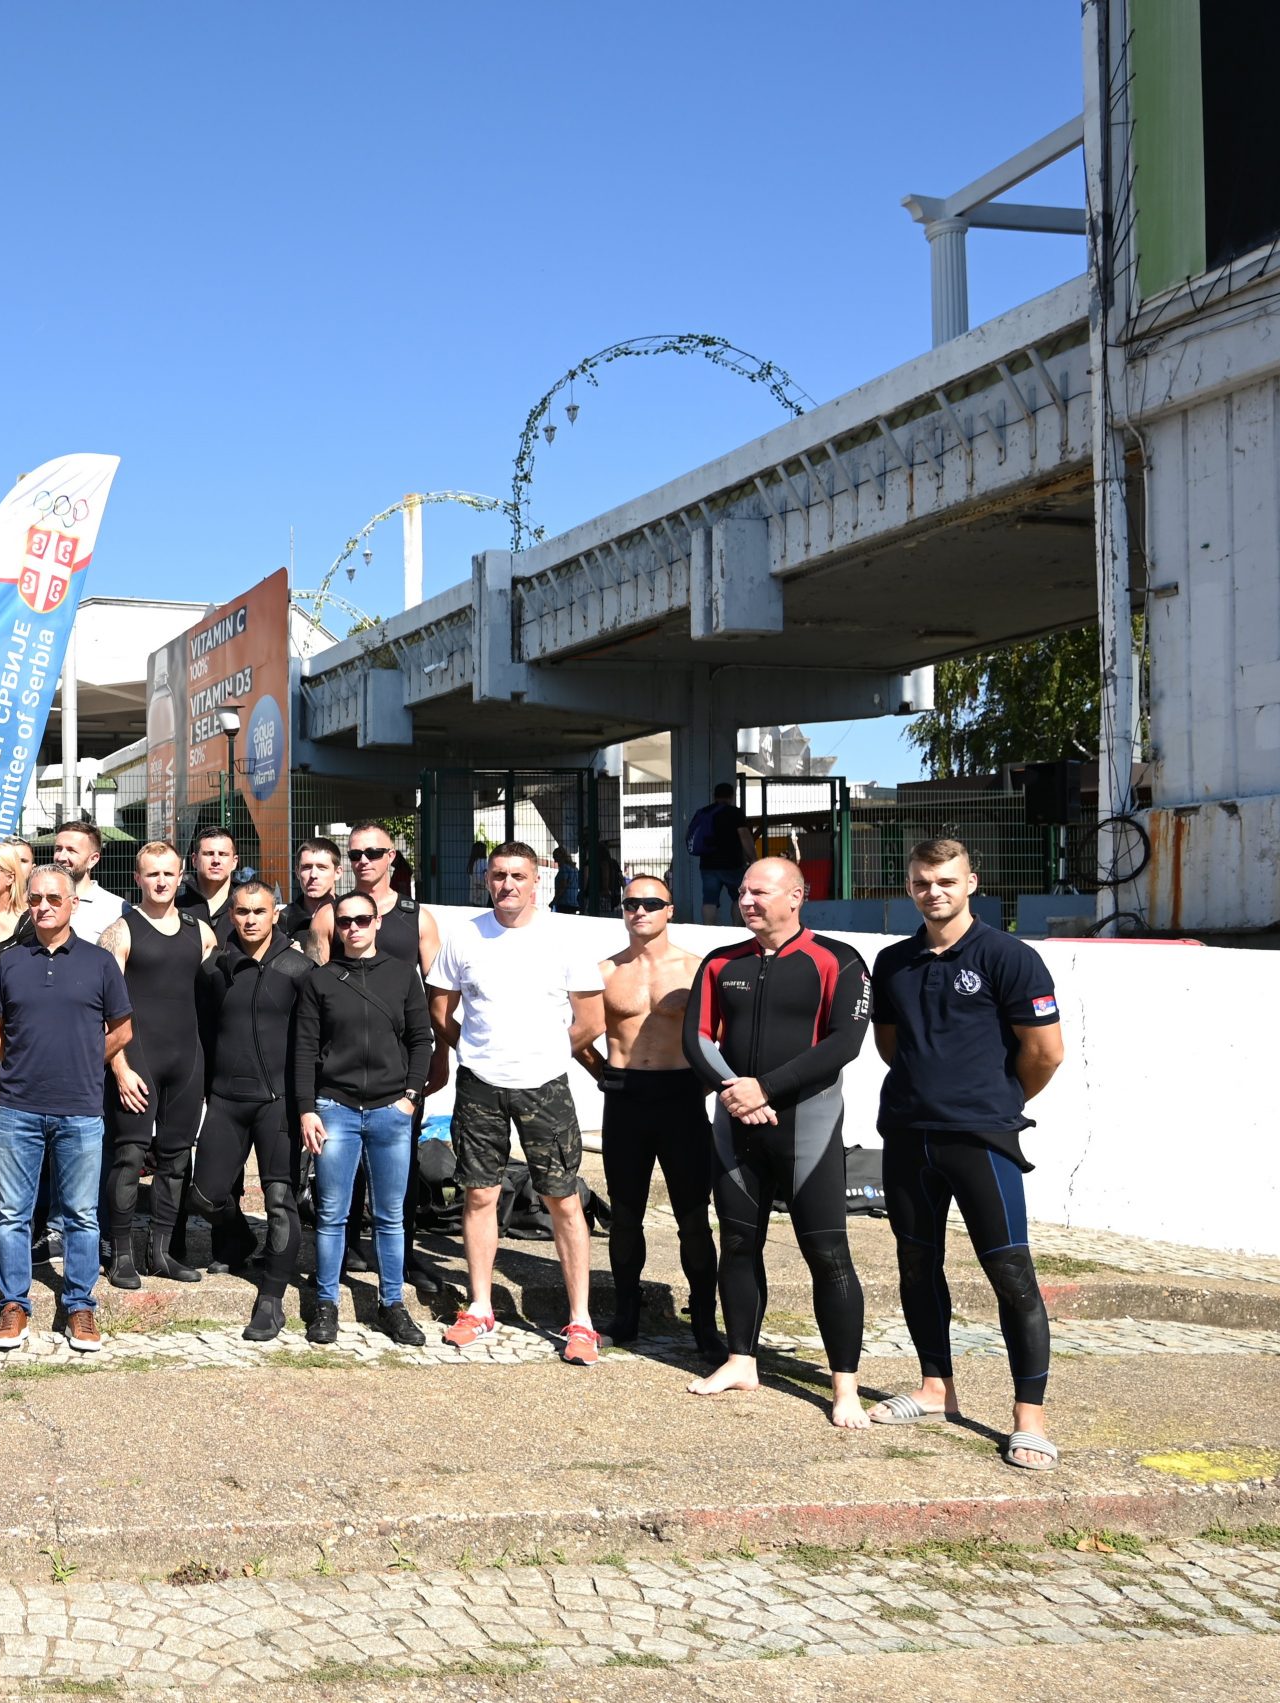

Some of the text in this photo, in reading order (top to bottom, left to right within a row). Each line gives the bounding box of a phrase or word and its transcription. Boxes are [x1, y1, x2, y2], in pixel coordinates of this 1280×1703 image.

[190, 608, 245, 660] VITAMIN C
[22, 628, 55, 708] Serbia
[190, 667, 251, 718] VITAMIN D3
[16, 710, 35, 740] of
[195, 711, 224, 743] SELE
[255, 738, 272, 759] viva
[254, 766, 275, 786] vitamin
[846, 1188, 863, 1196] QUA
